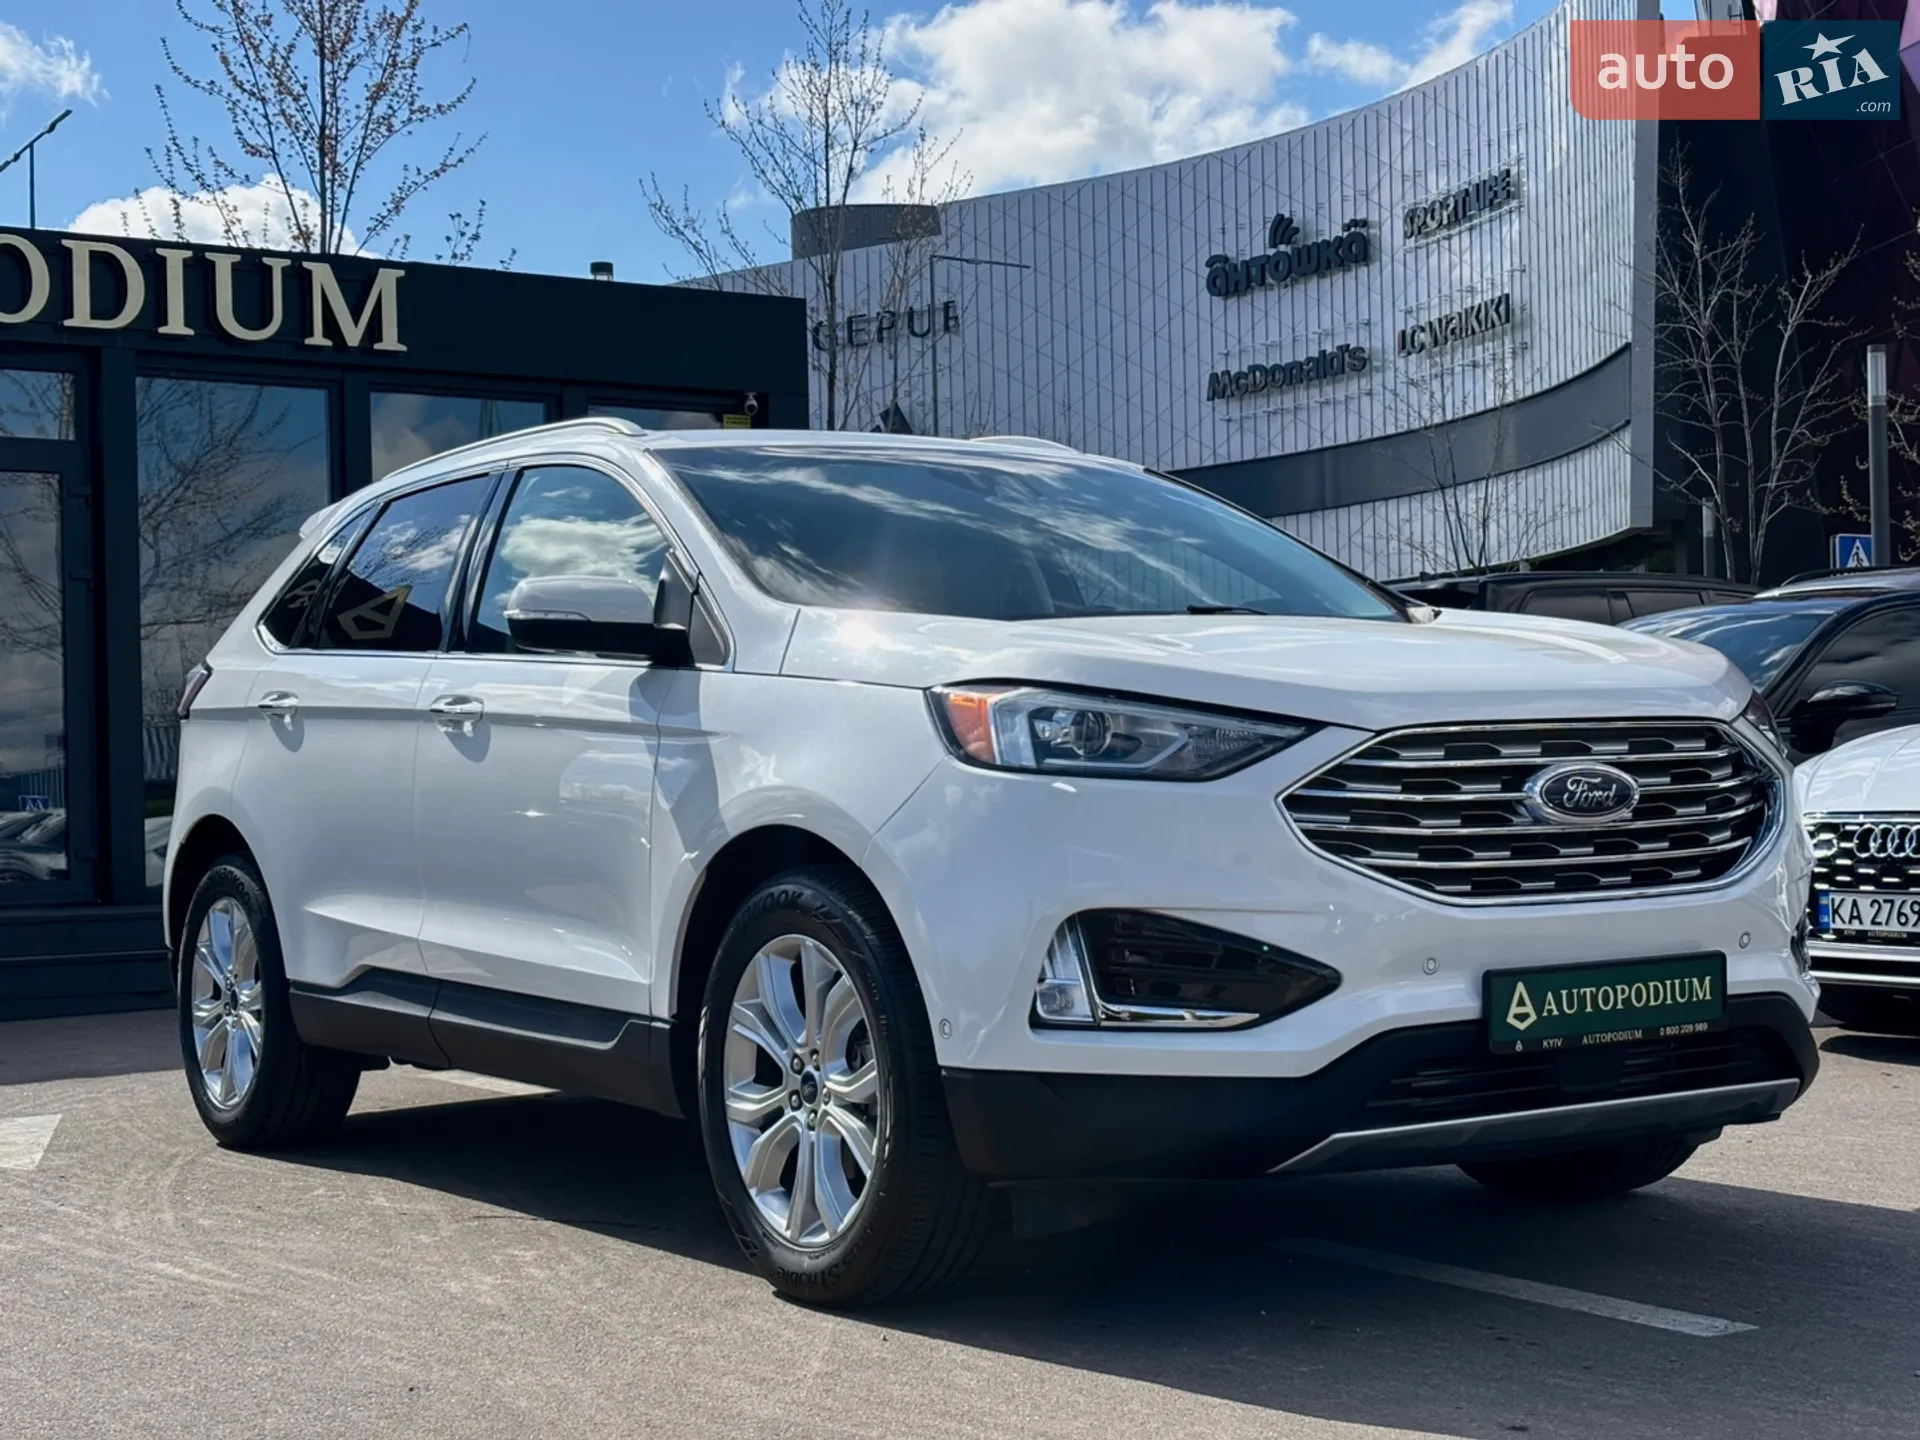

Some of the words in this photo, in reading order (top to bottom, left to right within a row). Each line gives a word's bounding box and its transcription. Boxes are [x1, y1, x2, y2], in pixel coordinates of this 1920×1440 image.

[1206, 343, 1368, 401] McDonald's
[1563, 776, 1617, 808] Ford
[1830, 897, 1863, 926] KA
[1542, 977, 1712, 1017] AUTOPODIUM
[1542, 1037, 1563, 1049] KYIV
[1582, 1029, 1643, 1046] AUTOPODIUM
